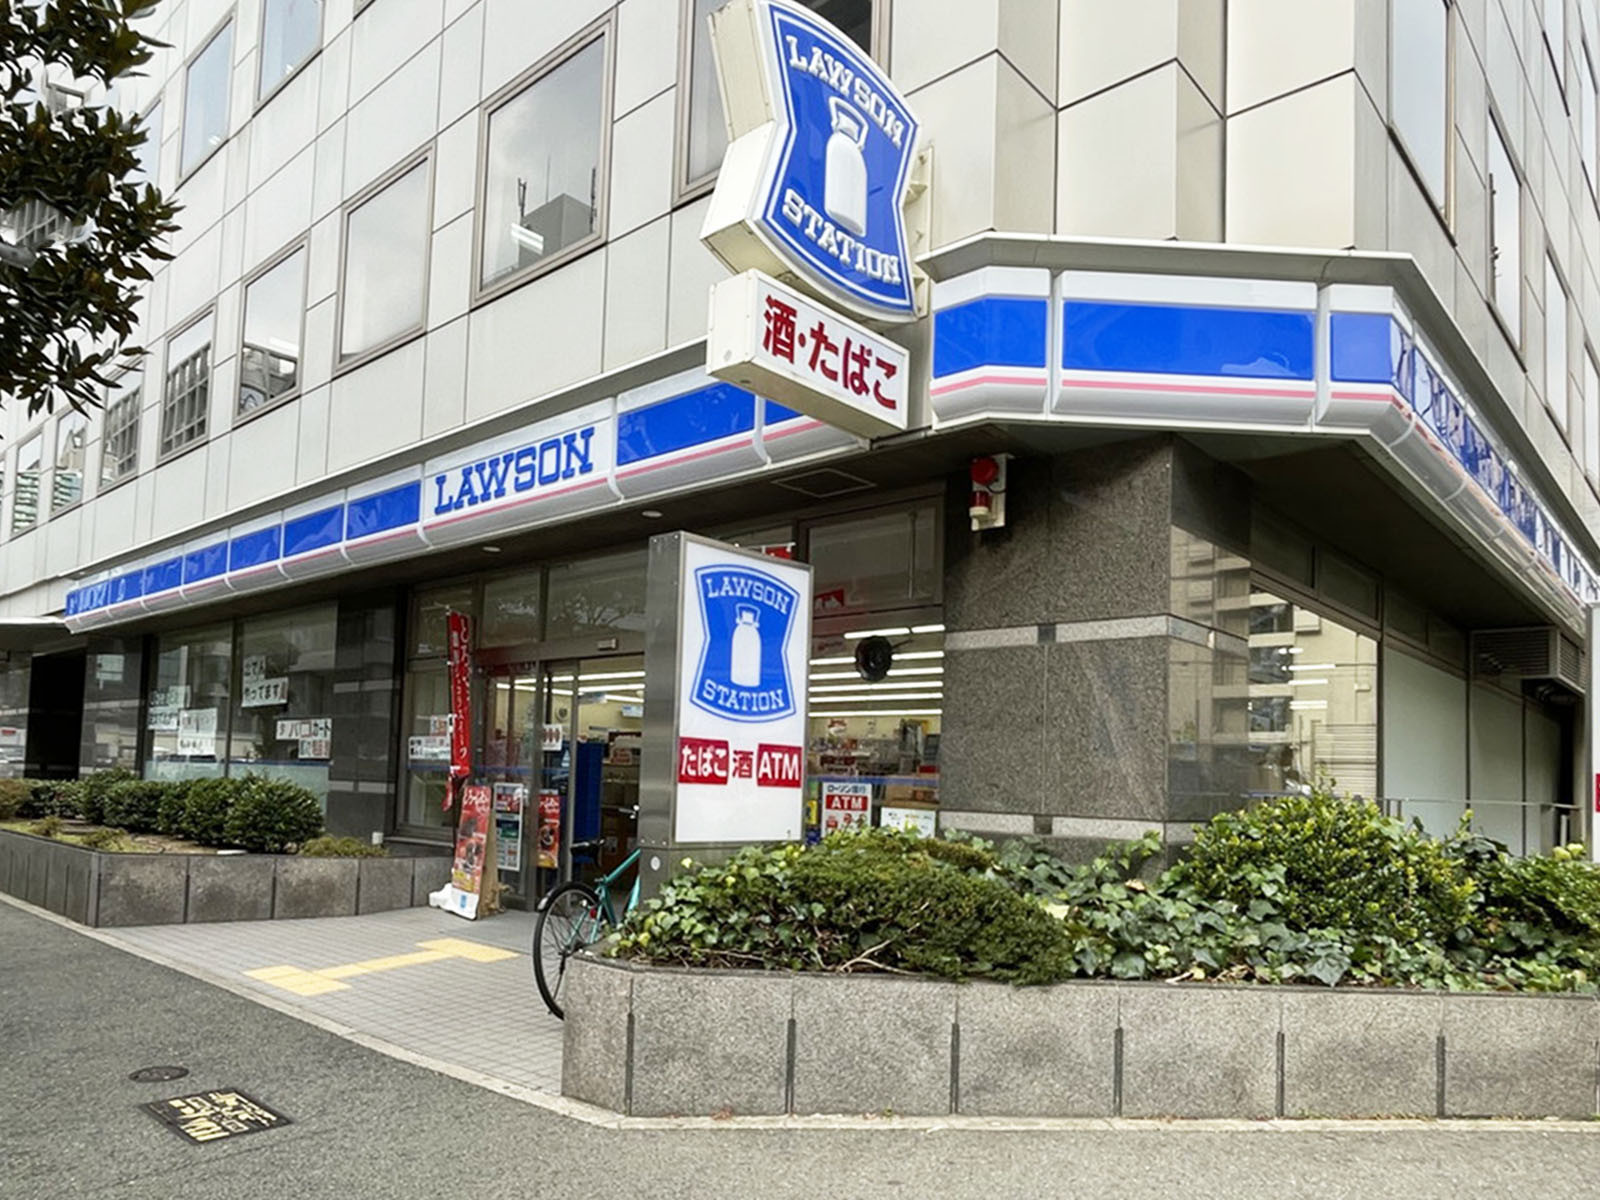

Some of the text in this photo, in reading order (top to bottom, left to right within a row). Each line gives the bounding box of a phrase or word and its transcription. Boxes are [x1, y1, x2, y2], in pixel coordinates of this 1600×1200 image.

[785, 34, 905, 150] LAWSON
[782, 187, 902, 285] STATION
[762, 294, 898, 412] 酒・たばこ
[434, 426, 595, 516] LAWSON
[705, 576, 791, 615] LAWSON
[702, 678, 785, 712] STATION
[680, 744, 729, 778] たばこ
[732, 749, 754, 779] 酒
[758, 750, 800, 781] ATM
[831, 796, 863, 809] ATM
